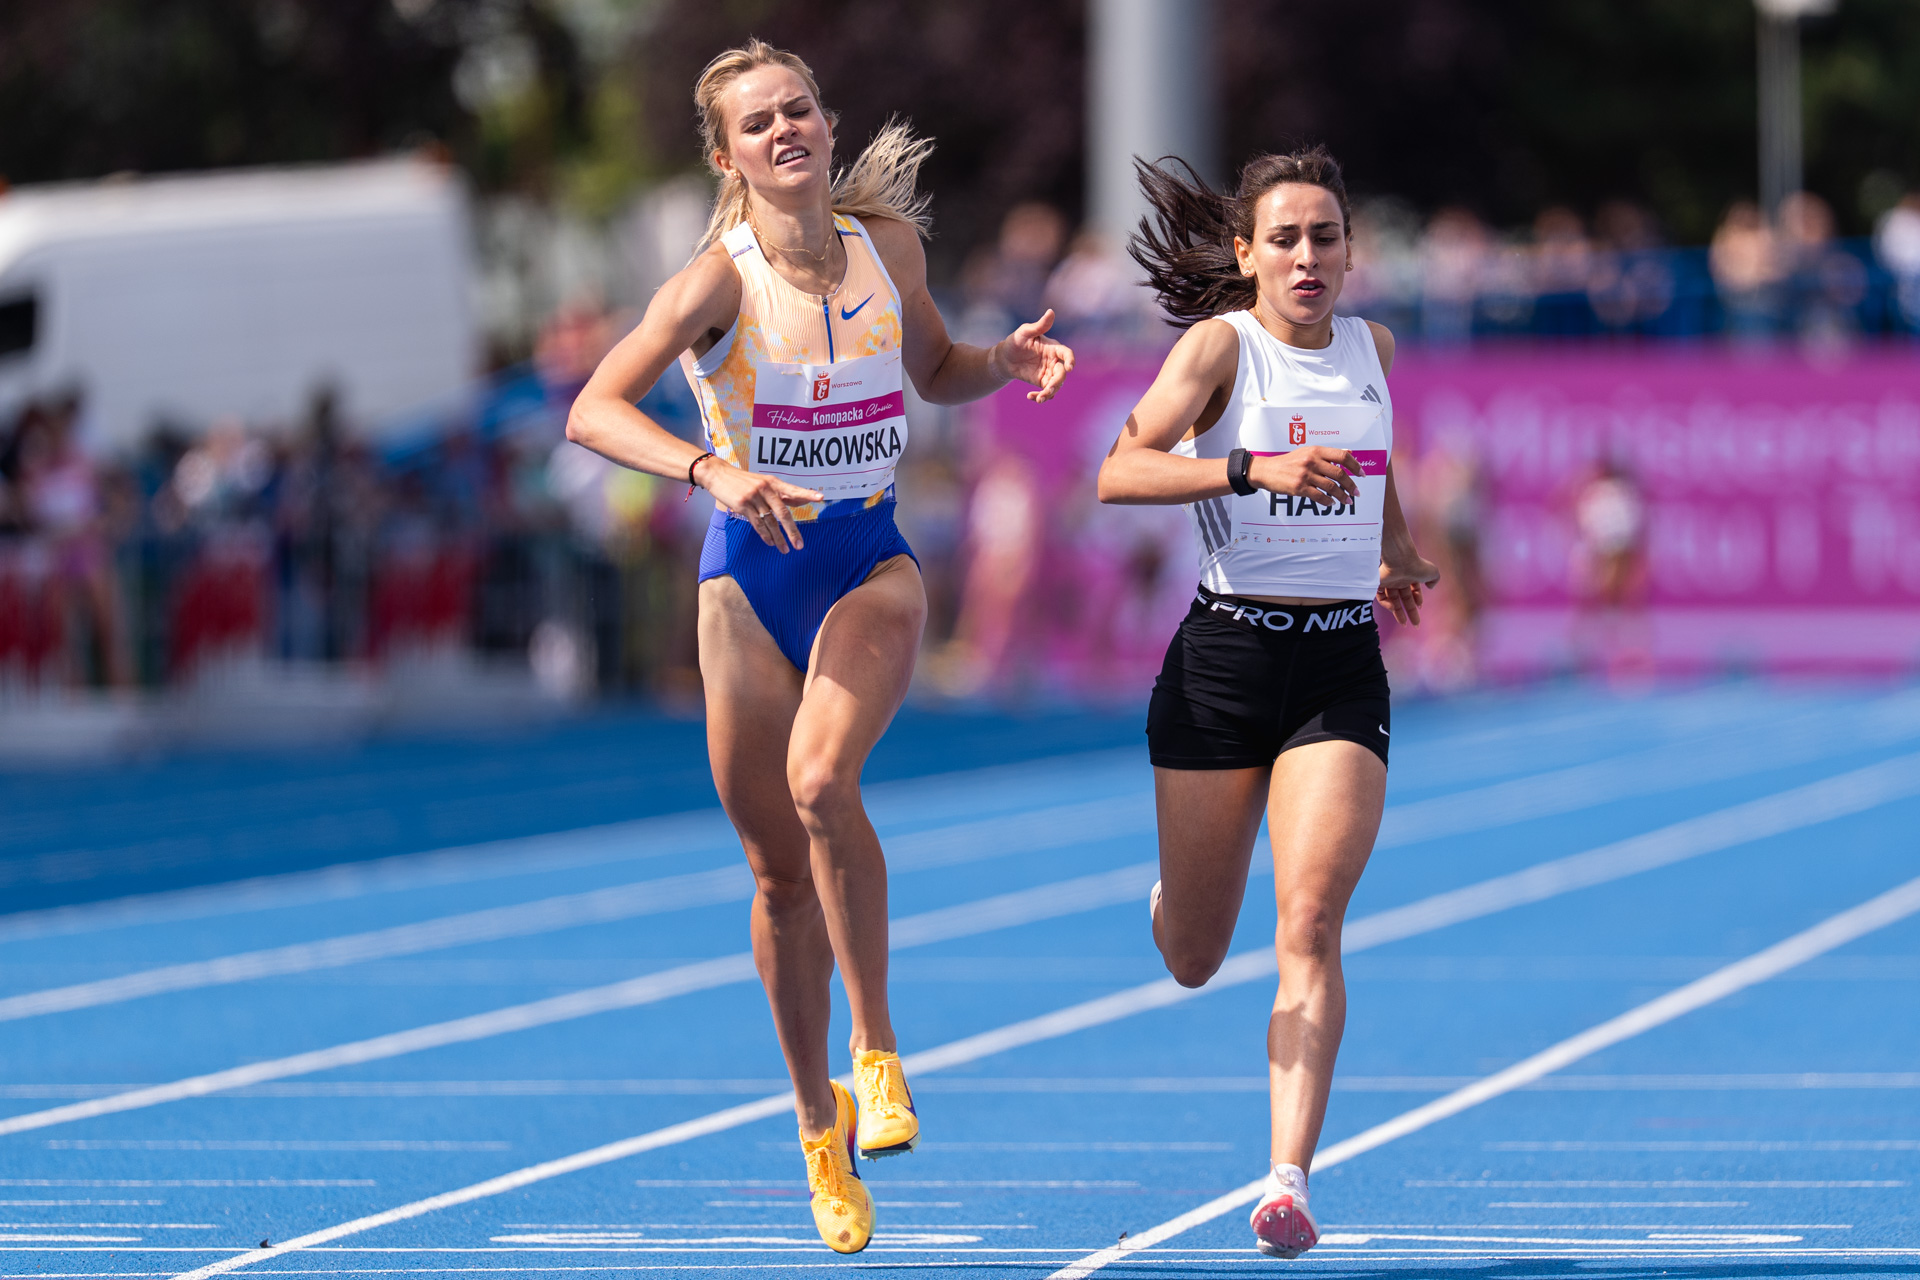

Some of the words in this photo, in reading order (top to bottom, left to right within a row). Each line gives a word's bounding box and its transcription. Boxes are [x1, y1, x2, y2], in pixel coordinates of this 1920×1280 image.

[831, 379, 862, 389] Warszawa
[767, 410, 809, 427] Halina
[812, 407, 863, 426] Konopacka
[865, 403, 893, 418] Classic
[757, 426, 901, 467] LIZAKOWSKA
[1210, 601, 1294, 631] PRO
[1303, 601, 1373, 633] NIKE
